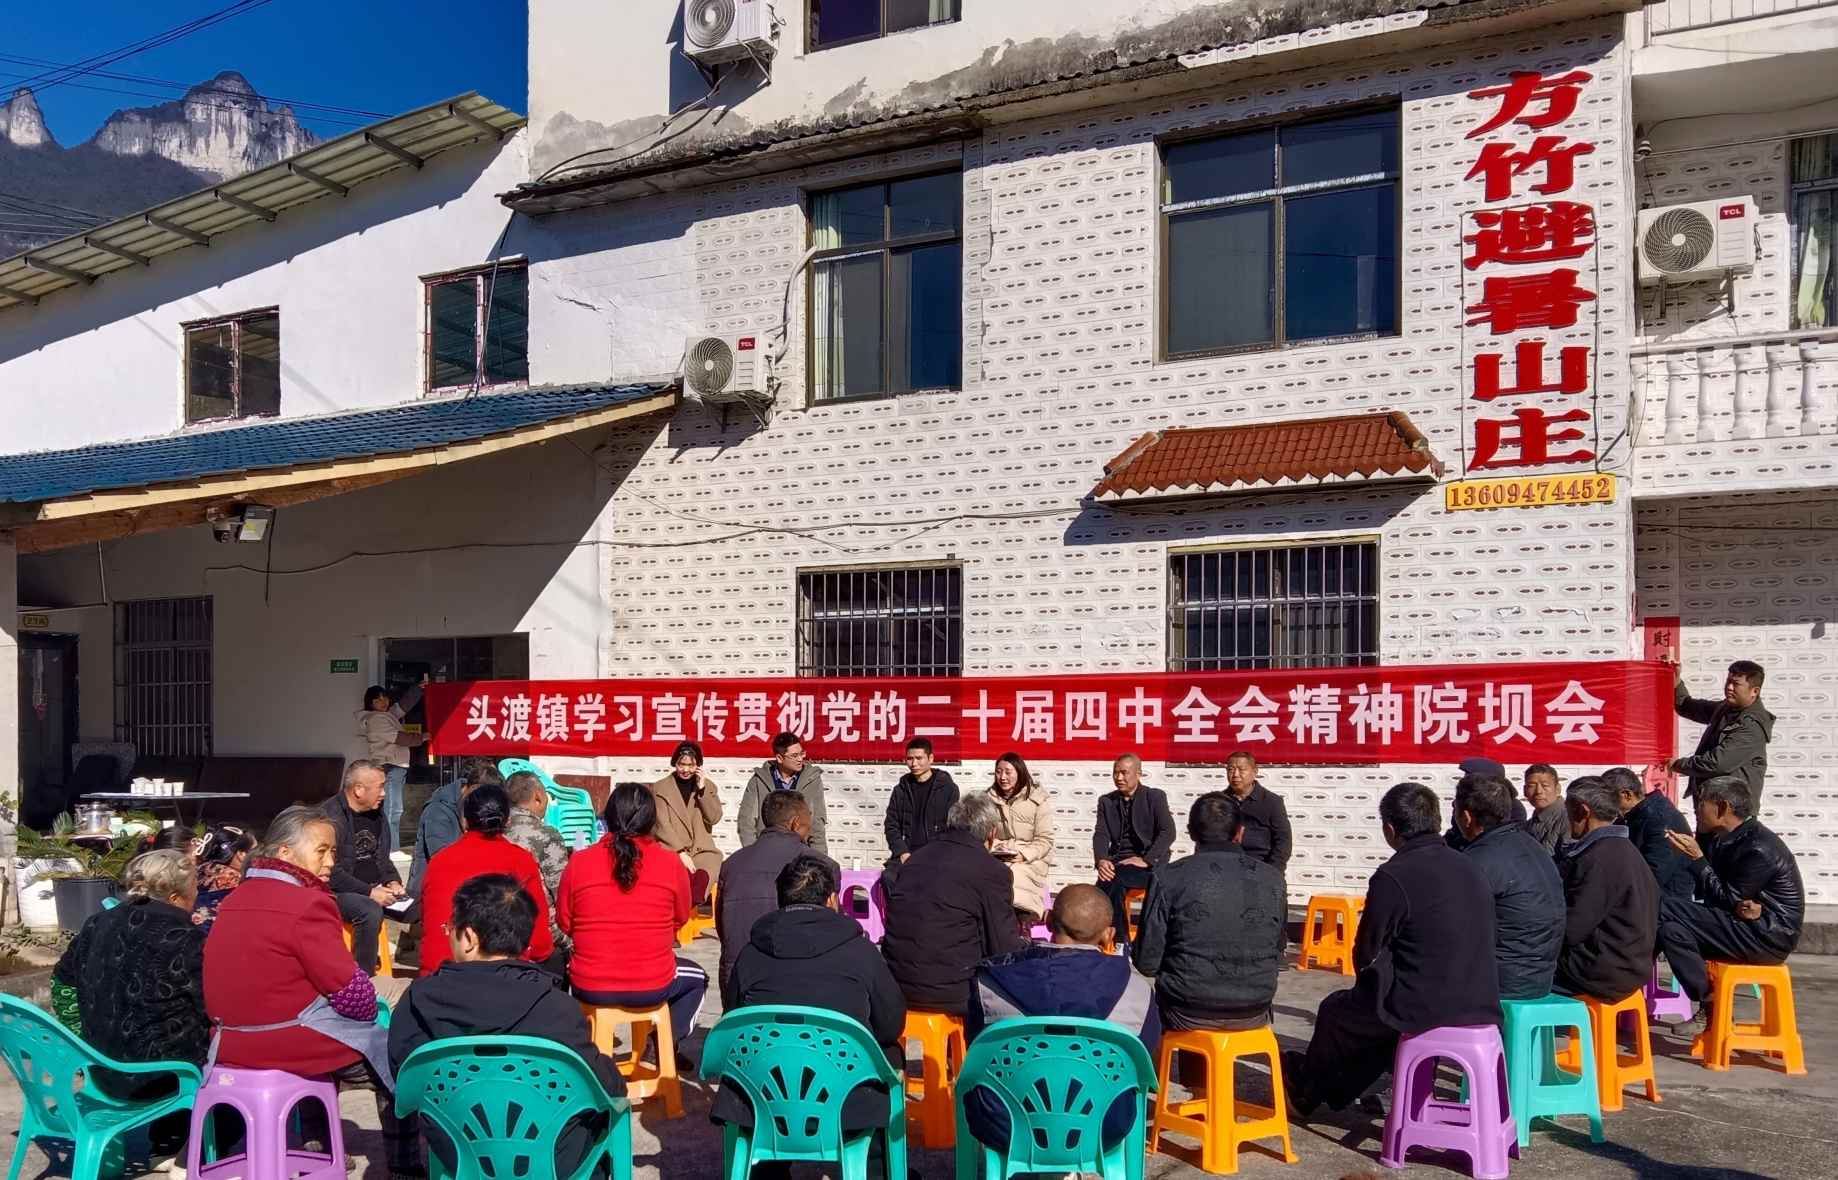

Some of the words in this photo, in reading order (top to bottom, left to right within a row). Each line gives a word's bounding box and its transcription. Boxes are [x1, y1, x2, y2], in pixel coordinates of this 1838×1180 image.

[1722, 208, 1742, 216] TCL
[1463, 70, 1597, 472] 方竹避暑山庄
[1450, 477, 1610, 507] 13609474452
[466, 679, 1606, 745] 头渡镇学习宣传贯彻党的二十届四中全会精神院坝会
